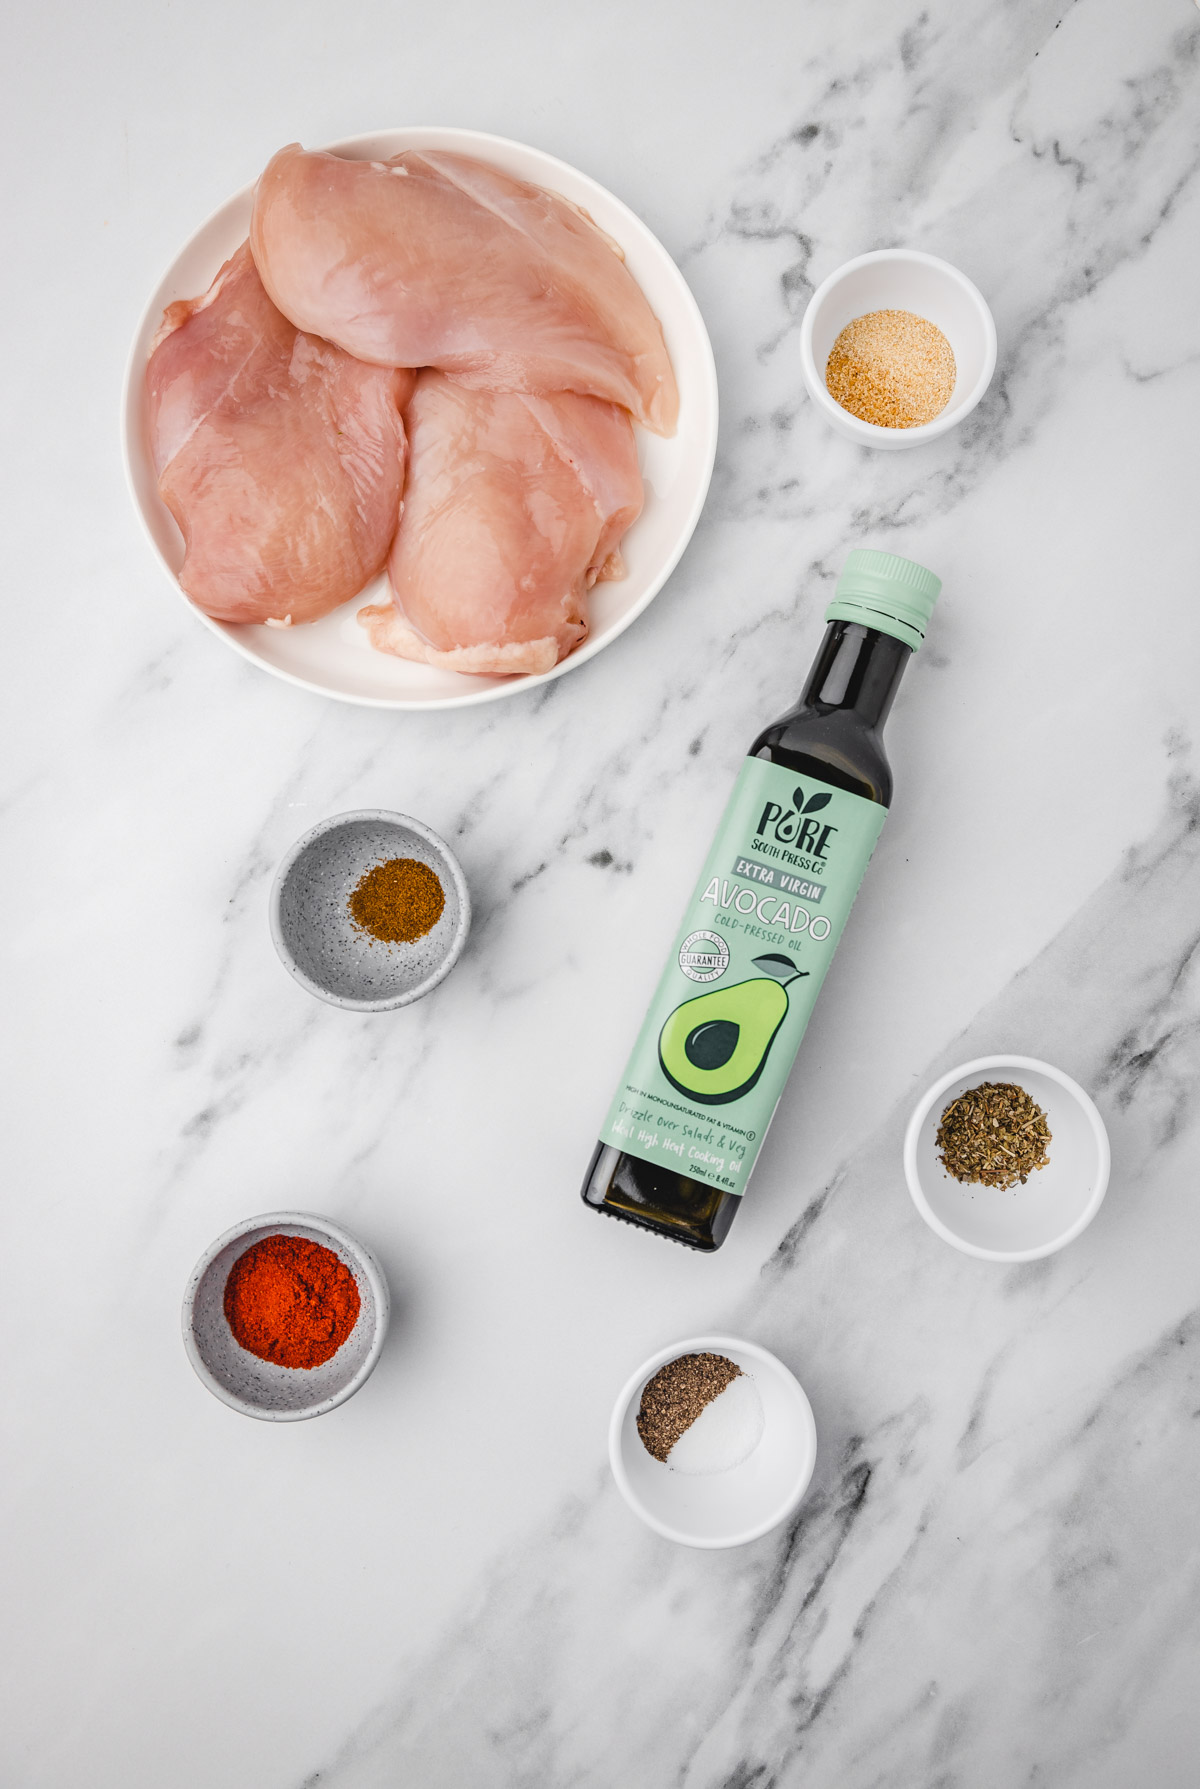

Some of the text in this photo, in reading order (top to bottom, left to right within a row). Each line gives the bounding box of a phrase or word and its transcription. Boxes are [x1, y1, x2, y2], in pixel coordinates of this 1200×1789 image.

[756, 801, 838, 860] PURE
[751, 838, 780, 858] SOUTH
[781, 849, 811, 871] PRESS
[736, 859, 822, 900] EXTRA VIRGIN
[699, 876, 832, 941] AVOCADO
[682, 932, 727, 953] WHOLE FOOD
[681, 954, 726, 967] GUARANTEE
[686, 969, 719, 981] QUALITY
[619, 1101, 653, 1122] Drizzle
[682, 1125, 714, 1144] Salads
[717, 1135, 726, 1148] &
[729, 1140, 746, 1160] Veg
[647, 1094, 706, 1121] MONOUNSATURATED
[706, 1116, 716, 1125] FAT
[722, 1122, 746, 1136] VITAMIN
[636, 1129, 658, 1149] High
[662, 1138, 685, 1157] Heat
[689, 1164, 707, 1177] 250ml
